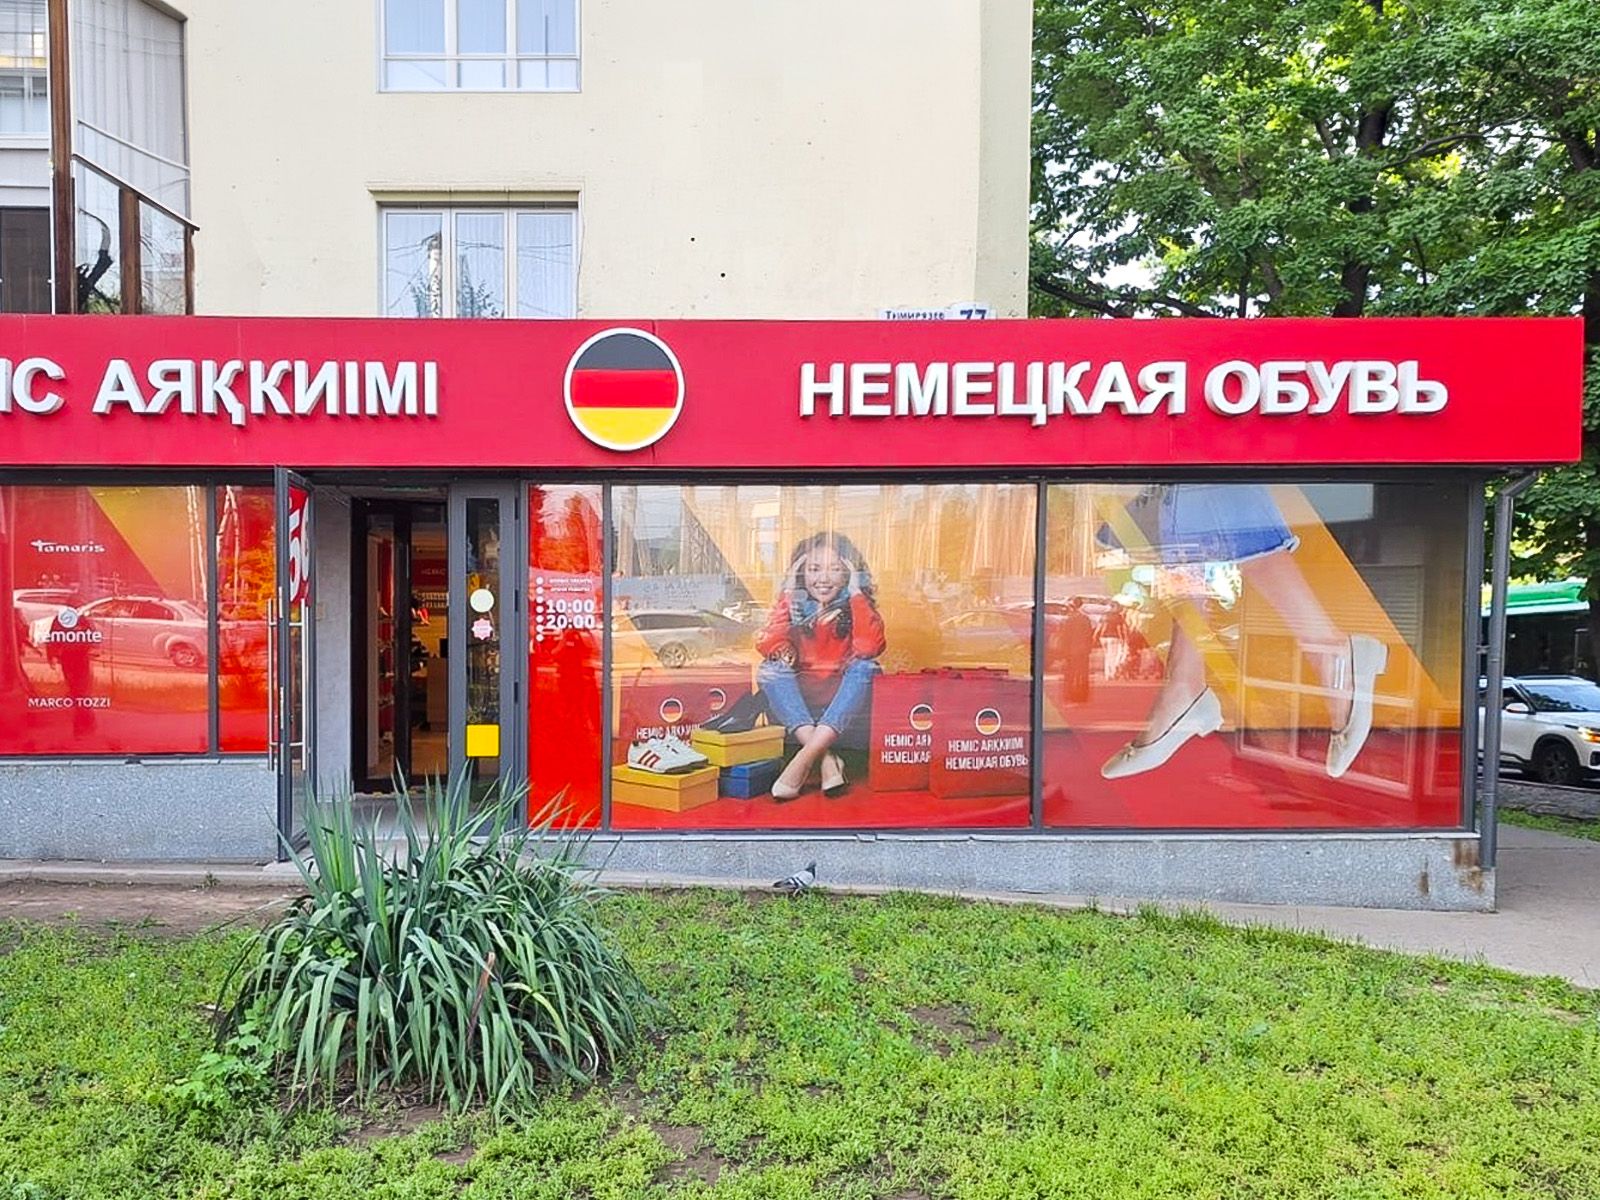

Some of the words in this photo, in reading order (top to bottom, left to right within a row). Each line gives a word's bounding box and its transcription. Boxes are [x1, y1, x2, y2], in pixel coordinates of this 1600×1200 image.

[960, 308, 988, 320] 77
[92, 359, 439, 427] АЯҚКИІМІ
[799, 361, 1188, 427] НЕМЕЦКАЯ
[1204, 359, 1449, 416] ОБУВЬ
[546, 599, 594, 613] 10:00
[546, 614, 596, 629] 20:00
[28, 697, 73, 708] MARCO
[77, 697, 111, 708] TOZZI
